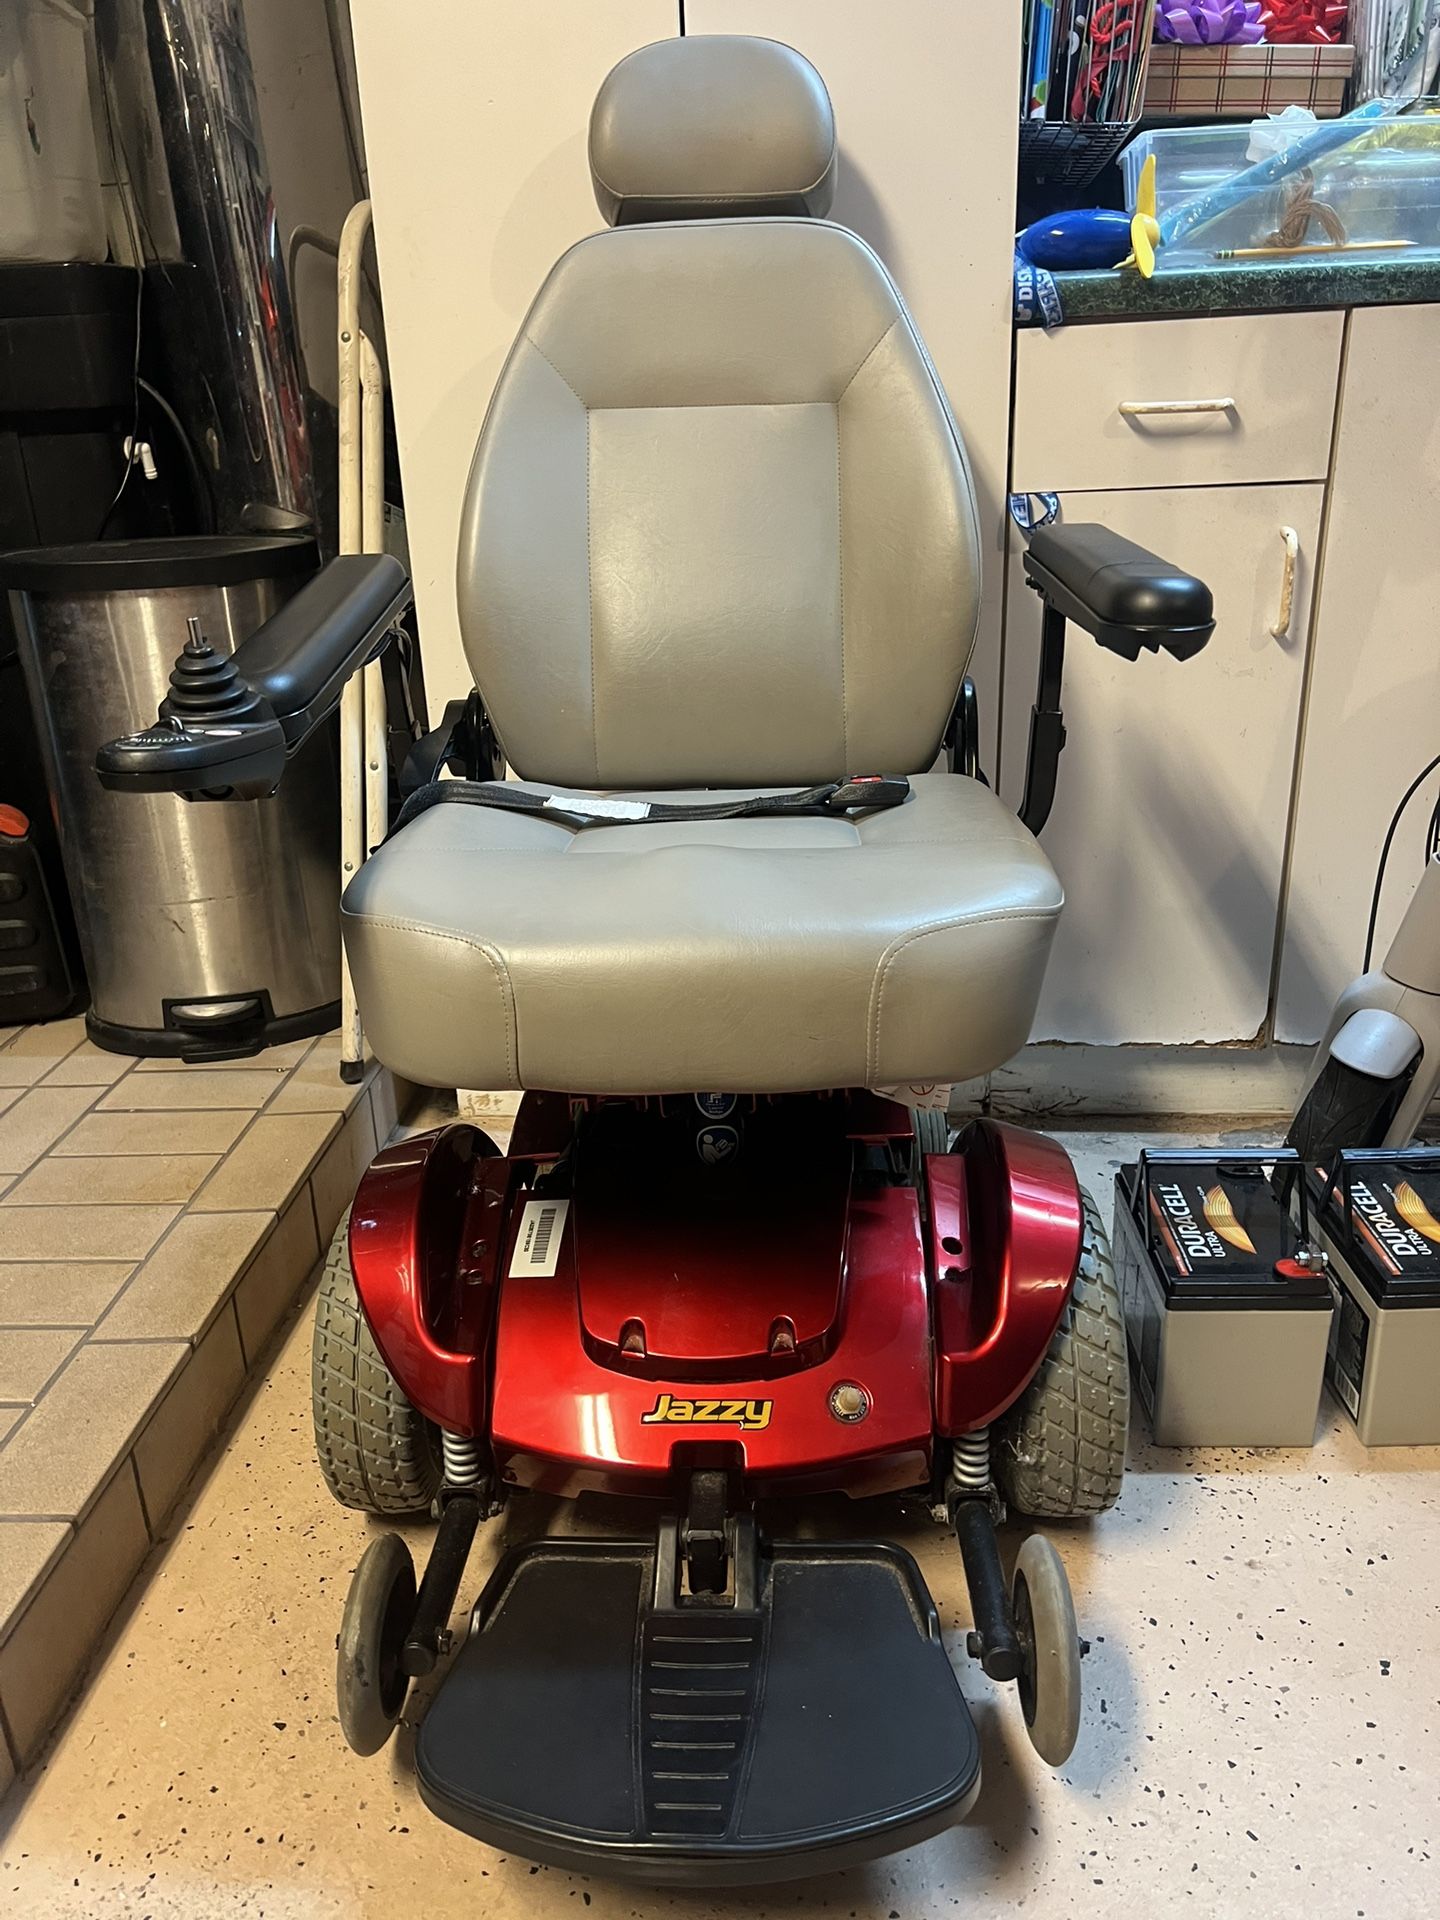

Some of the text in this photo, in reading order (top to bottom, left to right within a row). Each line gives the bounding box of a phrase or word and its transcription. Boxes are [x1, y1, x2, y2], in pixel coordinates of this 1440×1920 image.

[1159, 1183, 1212, 1257] DURACELL
[1350, 1181, 1418, 1256] DURACELL
[1205, 1231, 1226, 1258] ULTRA
[1404, 1228, 1432, 1255] ULTRA
[643, 1395, 773, 1430] Jazzy
